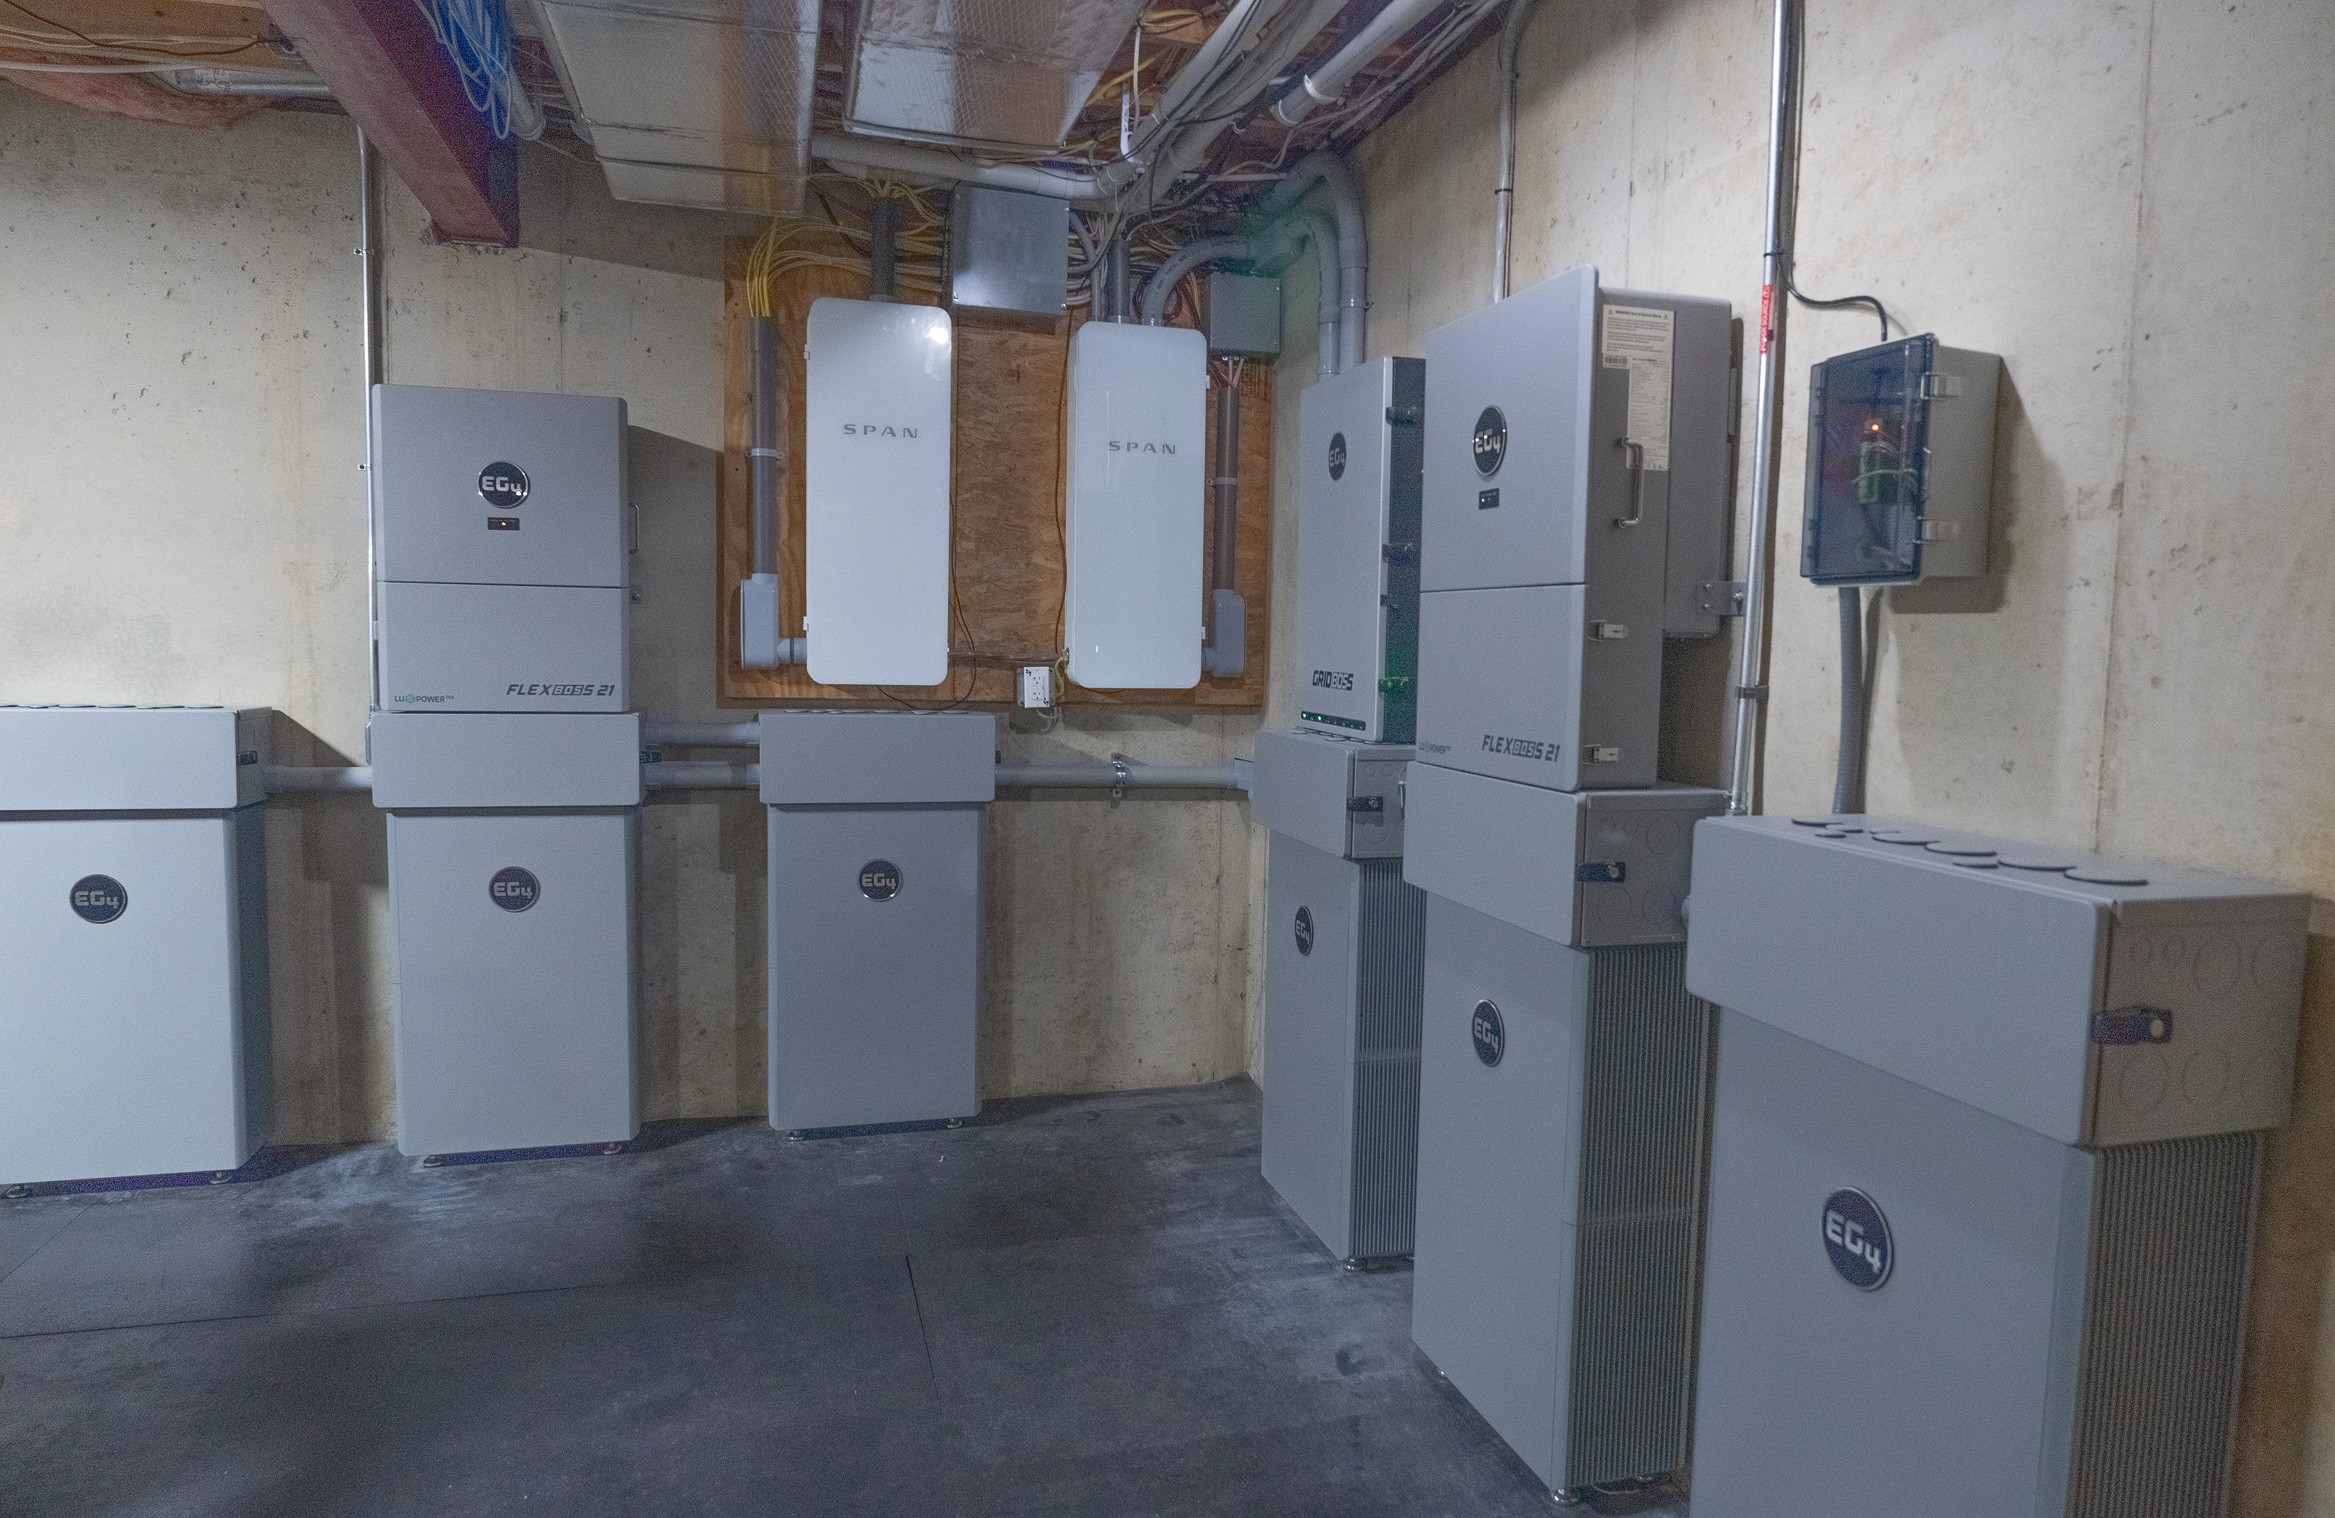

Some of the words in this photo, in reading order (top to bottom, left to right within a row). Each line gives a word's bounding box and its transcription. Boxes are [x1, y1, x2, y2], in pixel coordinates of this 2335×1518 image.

[843, 423, 918, 439] SPAN
[1474, 428, 1501, 454] EG4
[1108, 440, 1176, 455] SPAN
[1329, 447, 1346, 467] EG4
[482, 476, 522, 496] EG4
[506, 684, 595, 696] FLEXBOSS
[597, 685, 615, 696] 21
[1312, 670, 1354, 691] GRIDBOSS
[1481, 734, 1544, 759] FLEXBOSS
[1545, 743, 1560, 762] 21
[493, 881, 533, 899] EG4
[862, 872, 896, 890] EG4
[75, 890, 120, 909] EG4
[1296, 919, 1310, 945] EG4
[1474, 1016, 1499, 1054] EG4
[1826, 1209, 1881, 1275] EG4
